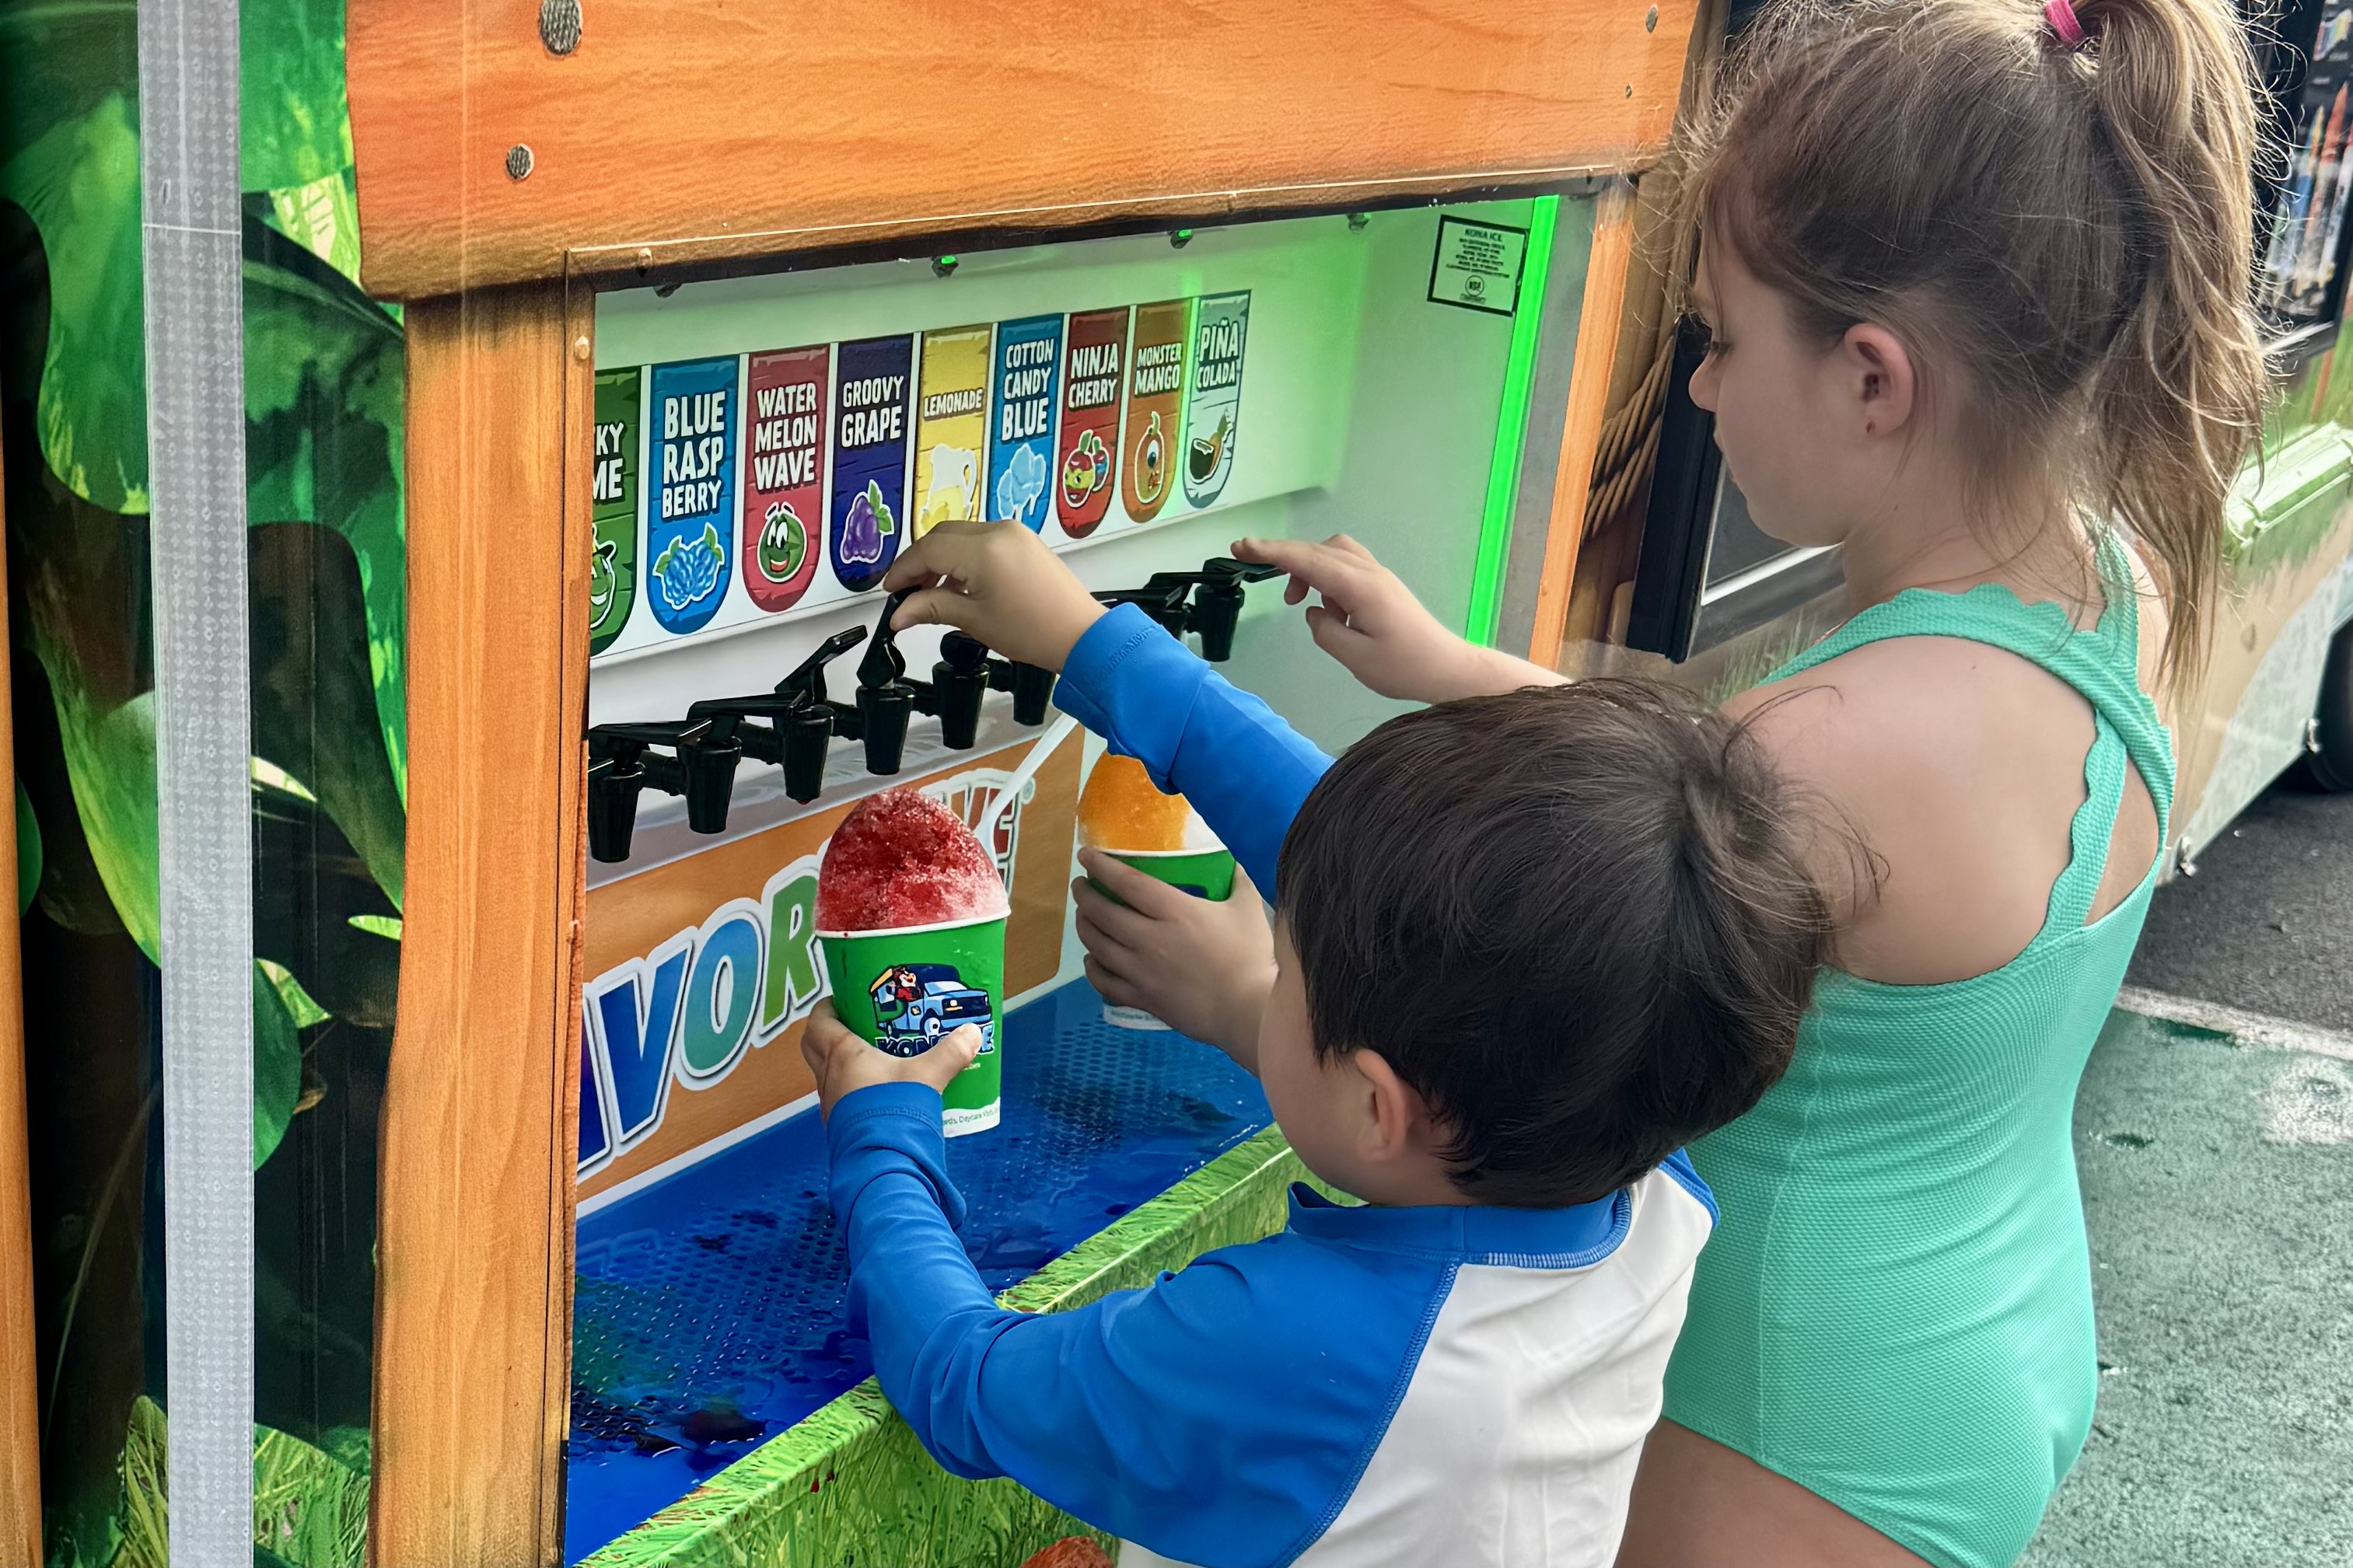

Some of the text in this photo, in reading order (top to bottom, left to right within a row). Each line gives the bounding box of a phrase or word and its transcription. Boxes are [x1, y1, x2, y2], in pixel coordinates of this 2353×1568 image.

[1005, 339, 1054, 368] COTTON
[1137, 343, 1182, 366] MONSTER
[1199, 318, 1239, 361] PIÑA
[1071, 343, 1118, 379] NINJA
[1196, 361, 1236, 388] COLADA
[842, 376, 904, 407] GROOVY
[1004, 368, 1051, 400] CANDY
[1068, 379, 1117, 409] CHERRY
[1135, 364, 1180, 396] MANGO
[664, 391, 725, 440] BLUE
[757, 382, 816, 418] WATER
[924, 389, 982, 417] LEMONADE
[754, 415, 817, 453] MELON
[841, 406, 902, 448] GRAPE
[1002, 397, 1048, 441] BLUE
[663, 437, 723, 484] RASP
[753, 449, 815, 491] WAVE
[662, 480, 722, 519] BERRY
